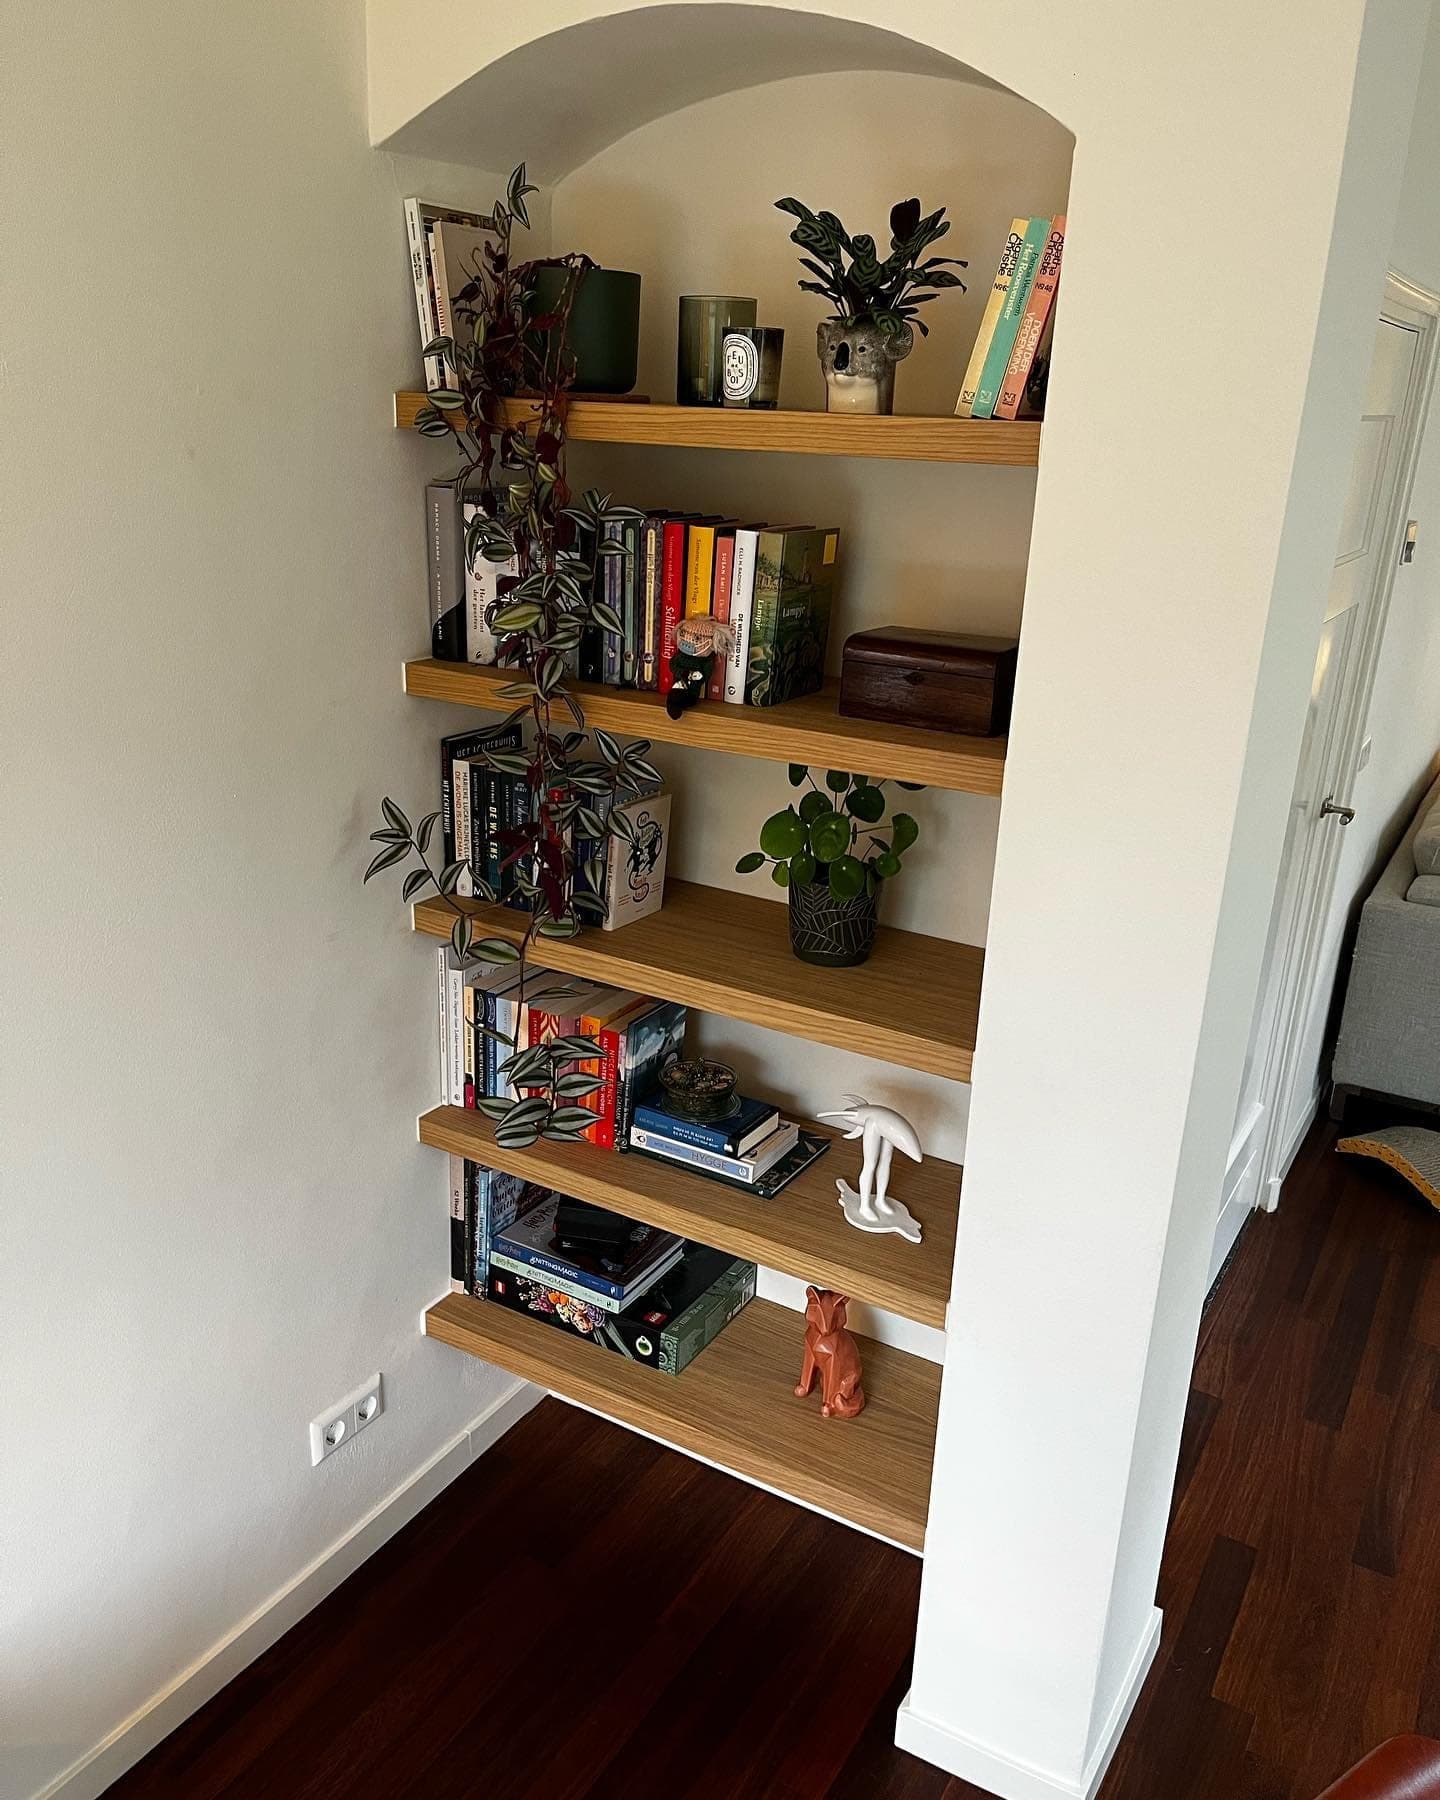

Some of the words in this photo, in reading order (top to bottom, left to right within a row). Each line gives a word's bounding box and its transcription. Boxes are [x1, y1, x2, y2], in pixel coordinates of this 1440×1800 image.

[998, 232, 1018, 276] Christie
[1006, 236, 1024, 277] Agatha
[1039, 231, 1061, 275] Christie
[1048, 235, 1065, 276] Agatha
[1008, 311, 1036, 375] VERDENKING
[1024, 319, 1042, 352] DOEM
[727, 350, 744, 365] FEU
[1019, 352, 1032, 373] DER
[754, 600, 765, 631] Lampje
[782, 603, 806, 619] Lampje
[443, 793, 451, 834] ACHTERHUIS
[489, 806, 498, 819] DE
[608, 1050, 616, 1071] NICCI
[691, 1150, 727, 1169] HYGGE
